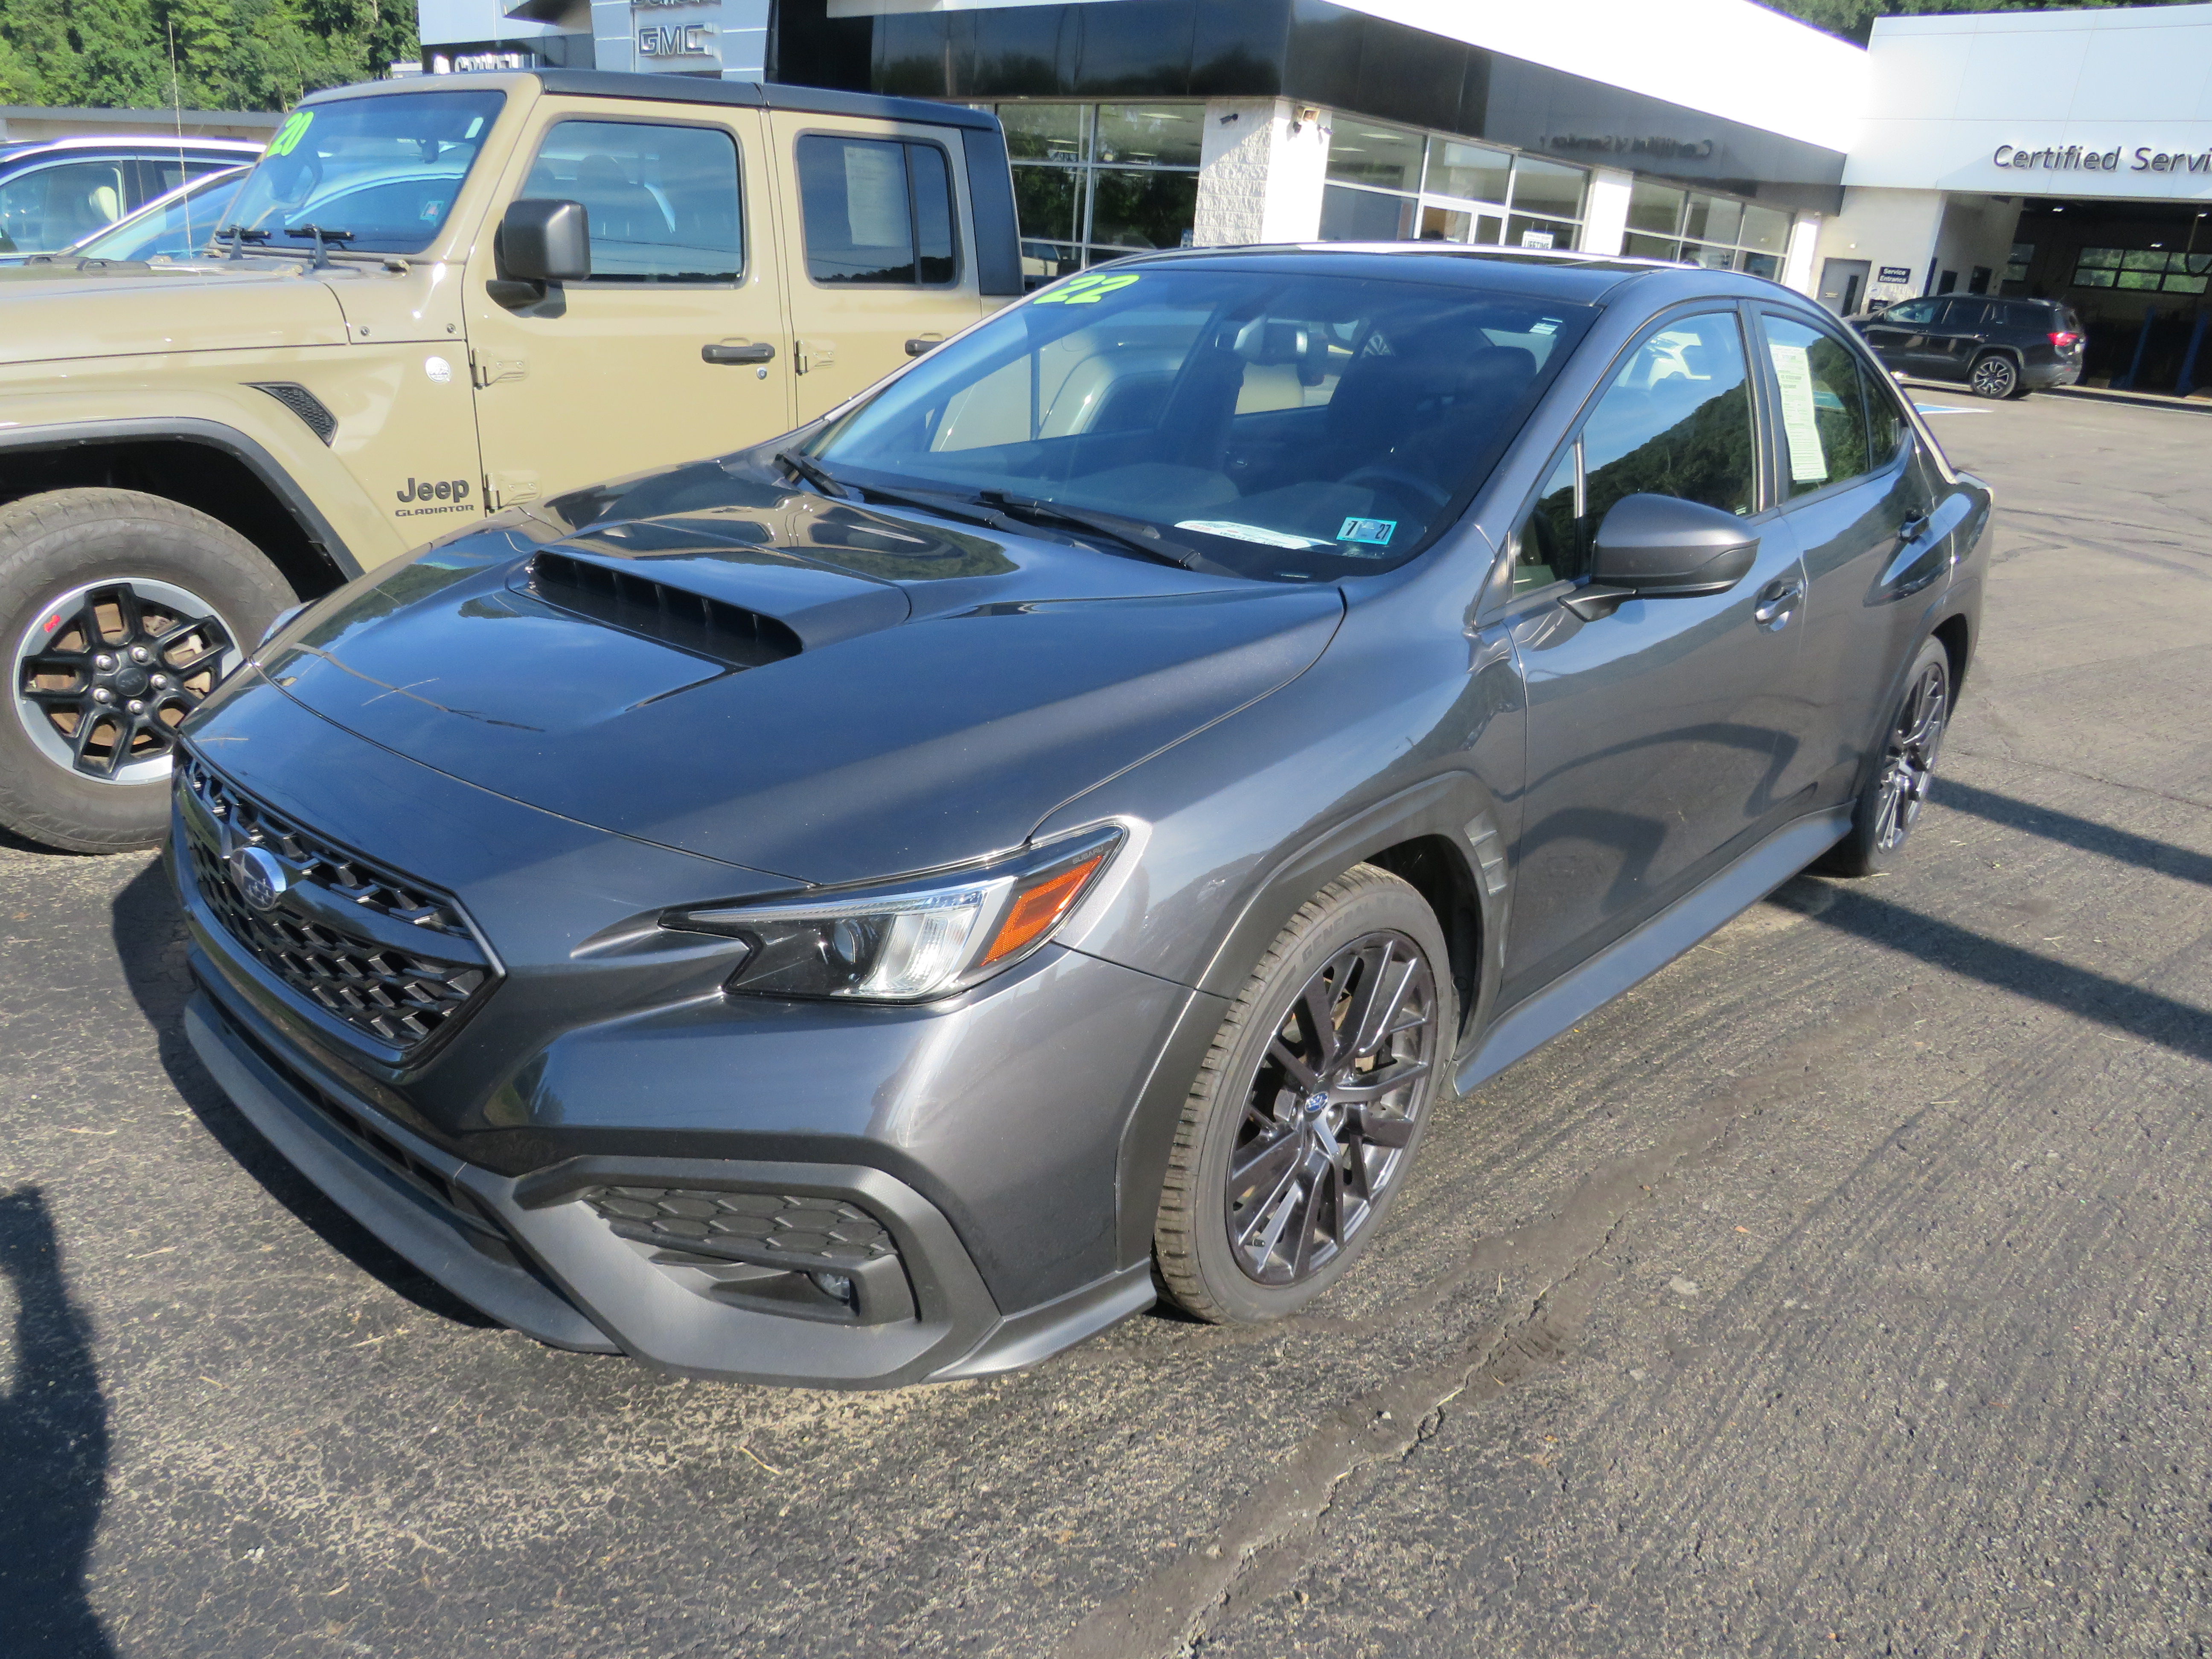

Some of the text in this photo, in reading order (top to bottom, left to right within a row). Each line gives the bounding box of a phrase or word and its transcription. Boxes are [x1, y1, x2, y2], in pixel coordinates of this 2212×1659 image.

[638, 23, 709, 56] GMC
[266, 111, 314, 157] 20
[1993, 145, 2212, 172] Certified Servi
[1033, 275, 1140, 304] 22
[396, 477, 470, 503] Jeep
[395, 504, 474, 517] GLADIATOR
[1345, 521, 1391, 540] 7 27
[1072, 846, 1103, 864] SUBARU
